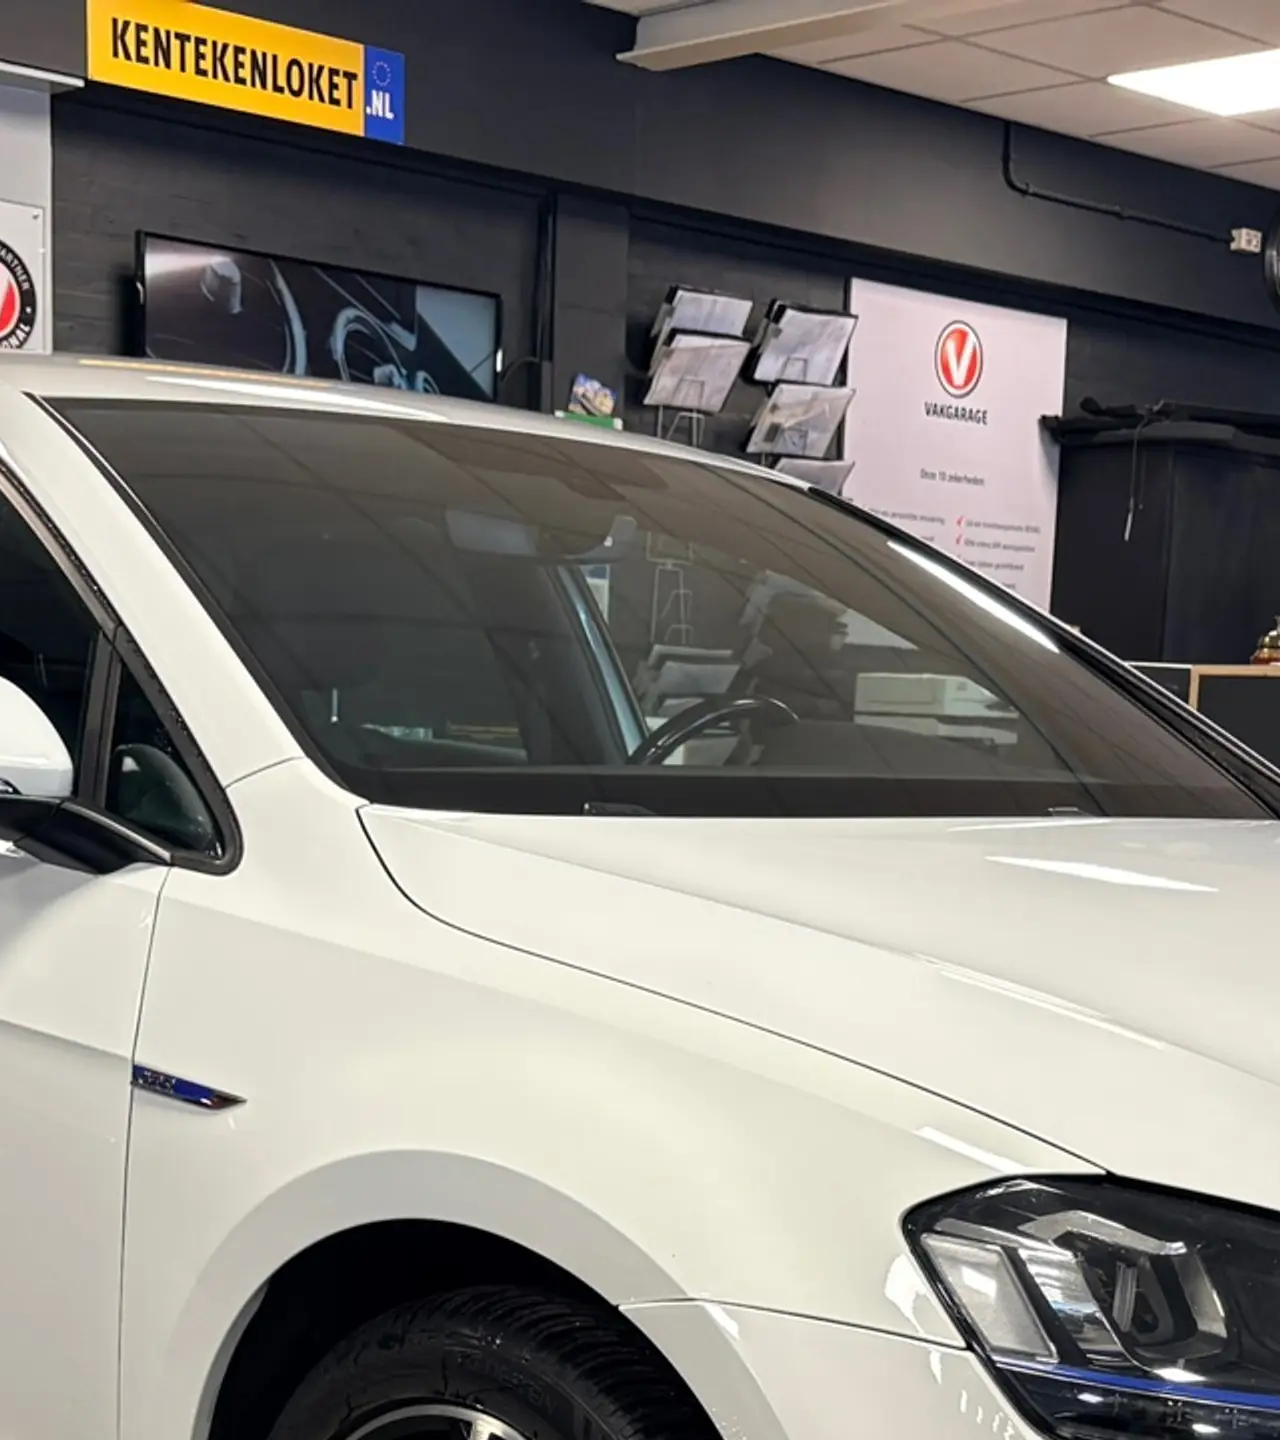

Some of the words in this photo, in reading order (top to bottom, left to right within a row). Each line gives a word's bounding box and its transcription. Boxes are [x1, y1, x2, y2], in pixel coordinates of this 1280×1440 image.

[111, 17, 359, 110] KENTEKENLOKET
[365, 89, 395, 121] .NL
[923, 401, 988, 426] VAKGARAGE
